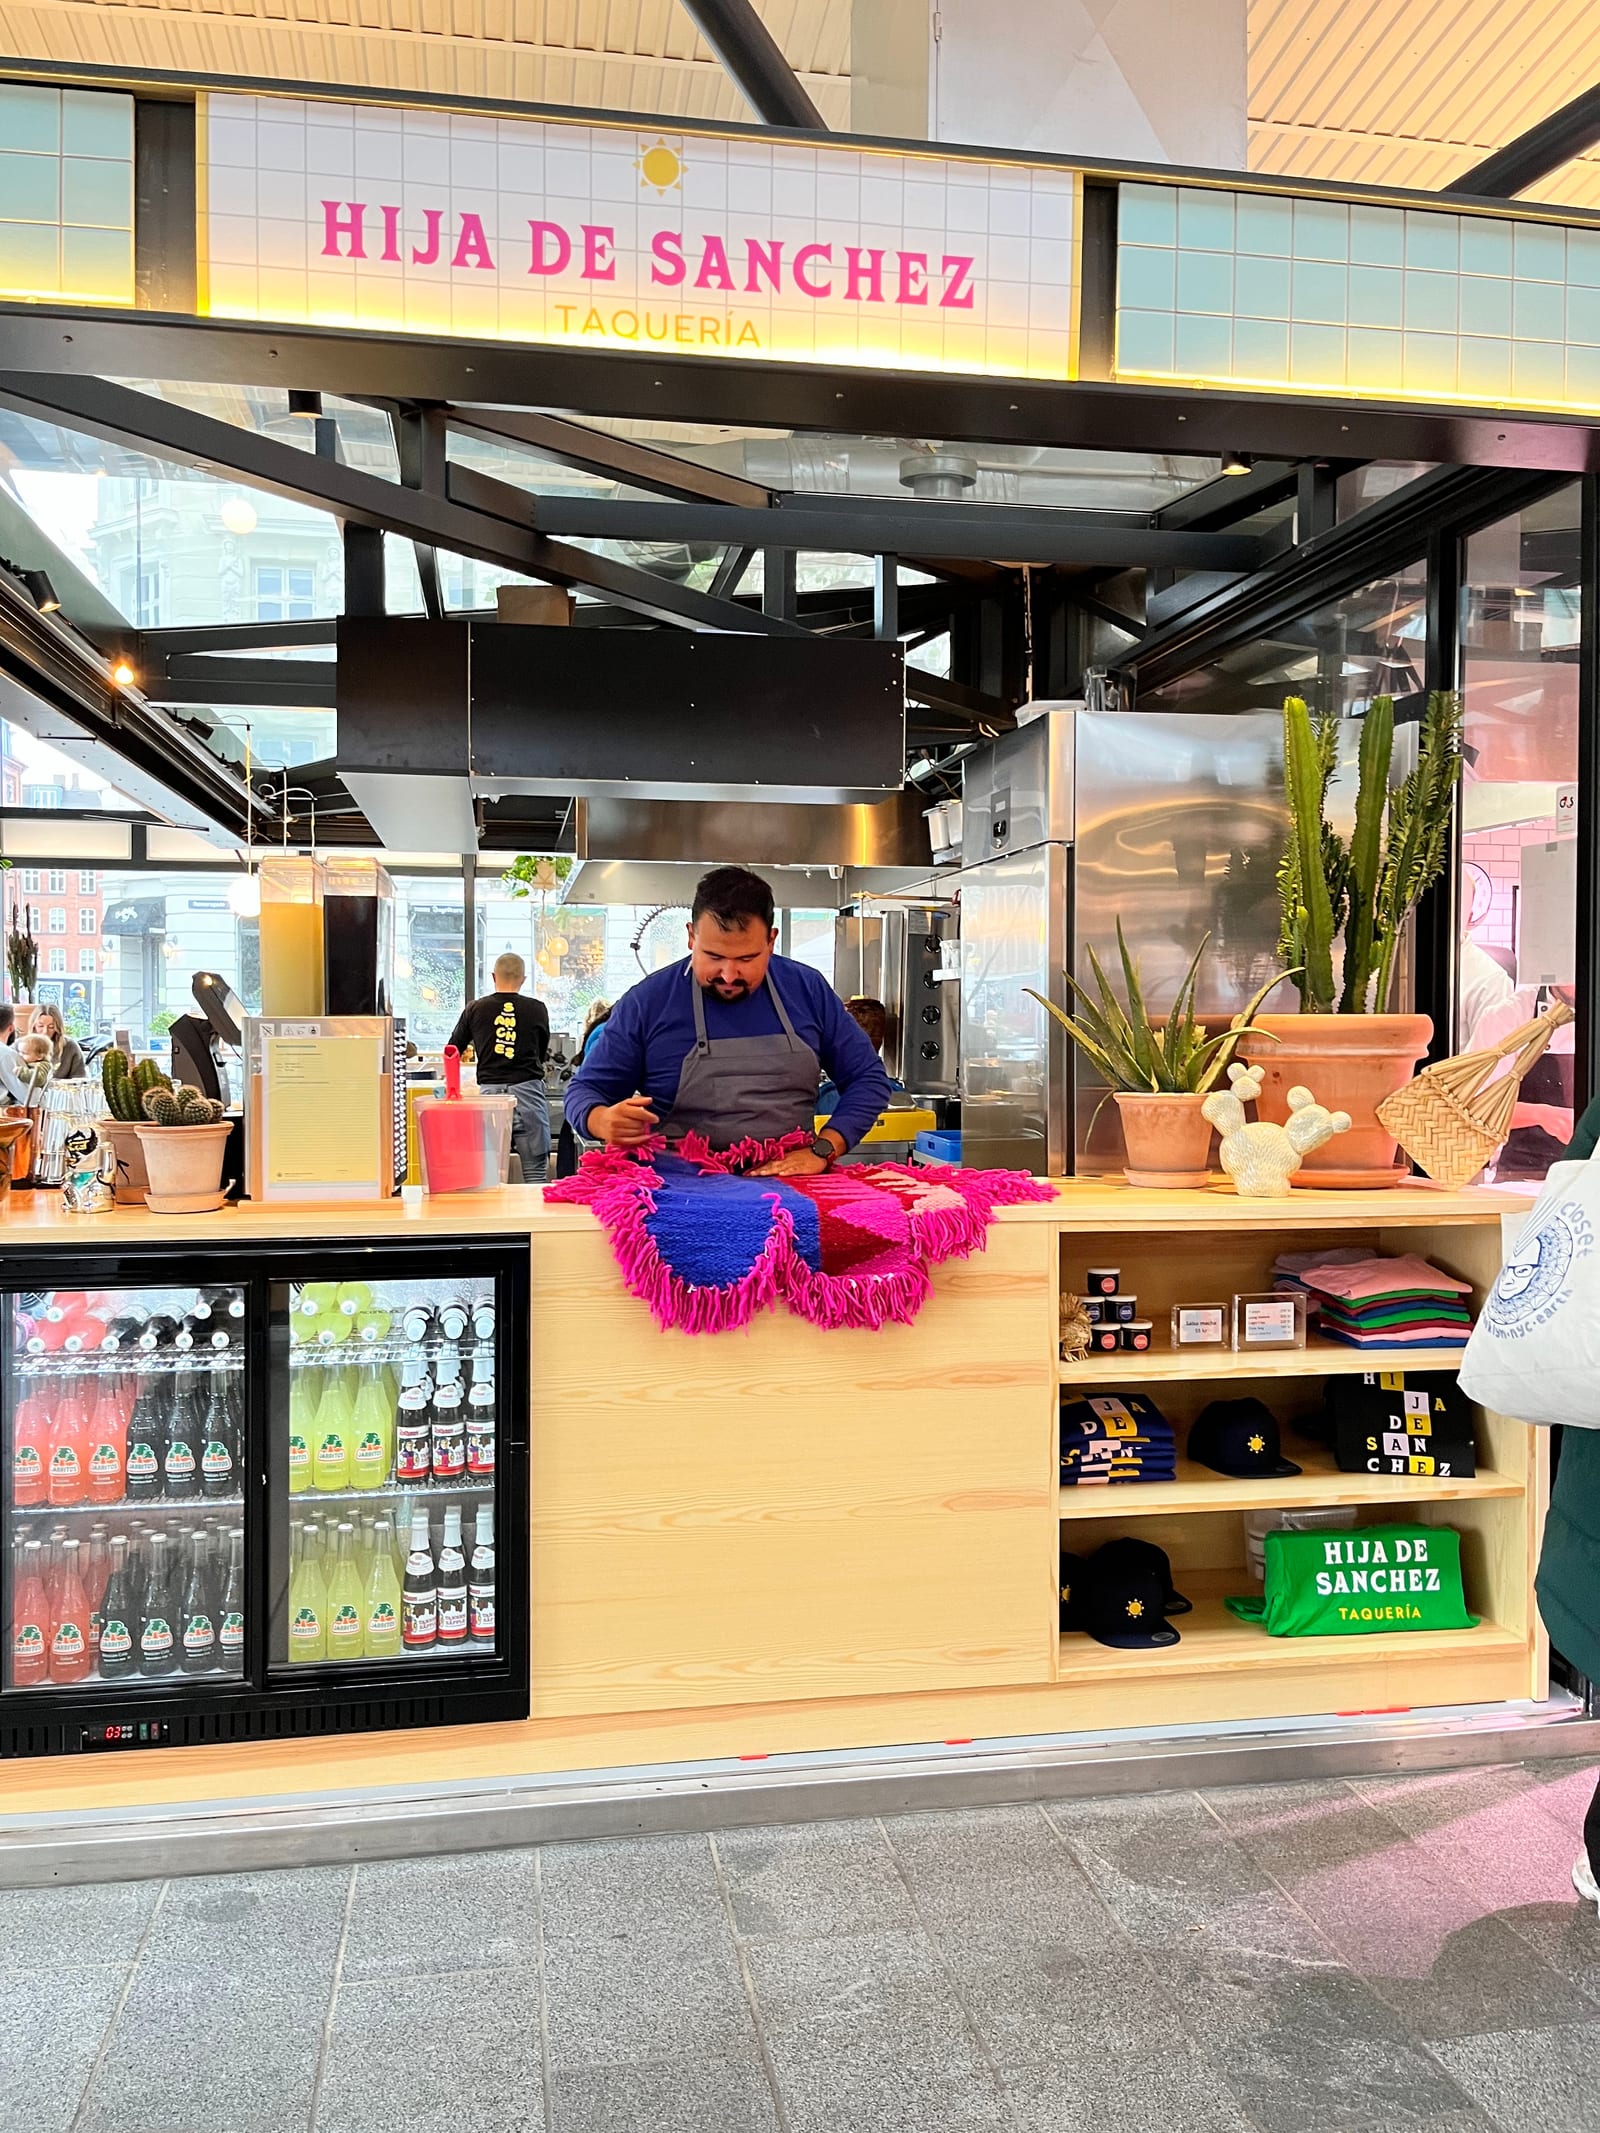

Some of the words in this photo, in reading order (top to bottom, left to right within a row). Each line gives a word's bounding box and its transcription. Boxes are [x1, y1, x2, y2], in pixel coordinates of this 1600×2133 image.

[320, 200, 496, 270] HIJA
[527, 220, 615, 281] DE
[651, 230, 975, 309] SANCHEZ
[554, 304, 761, 347] TAQUERÍA
[1560, 1201, 1594, 1259] closet
[1323, 1540, 1389, 1565] HIJA
[1394, 1539, 1428, 1562] DE
[1315, 1568, 1440, 1596] SANCHEZ
[1338, 1603, 1422, 1620] TAQUERÍA
[105, 1726, 121, 1739] 03
